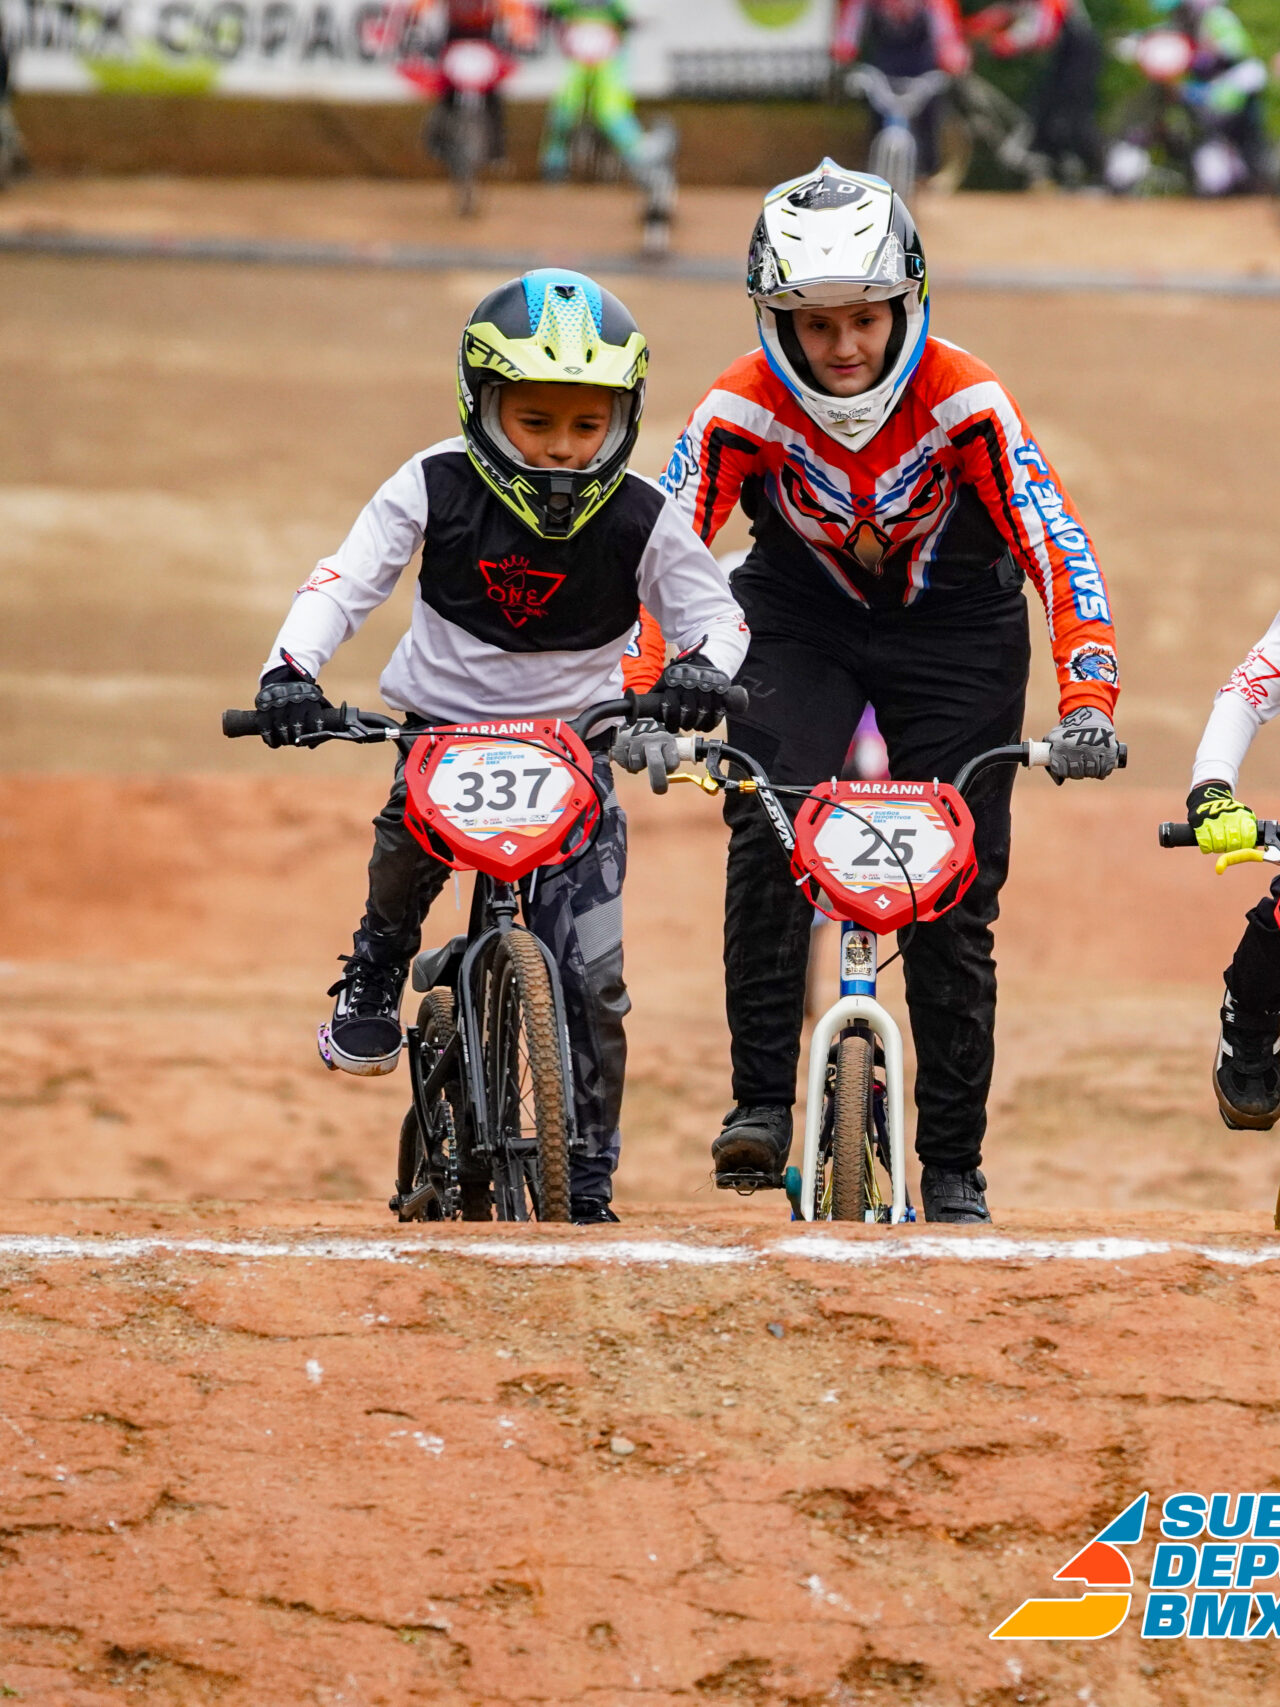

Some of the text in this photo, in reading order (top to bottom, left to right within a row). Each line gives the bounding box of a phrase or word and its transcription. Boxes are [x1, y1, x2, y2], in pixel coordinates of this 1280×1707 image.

[796, 183, 857, 200] TLD
[454, 721, 535, 739] MARLANN
[1062, 727, 1114, 748] FOX
[453, 767, 552, 813] 337
[849, 783, 925, 795] MARLANN
[851, 828, 918, 868] 25
